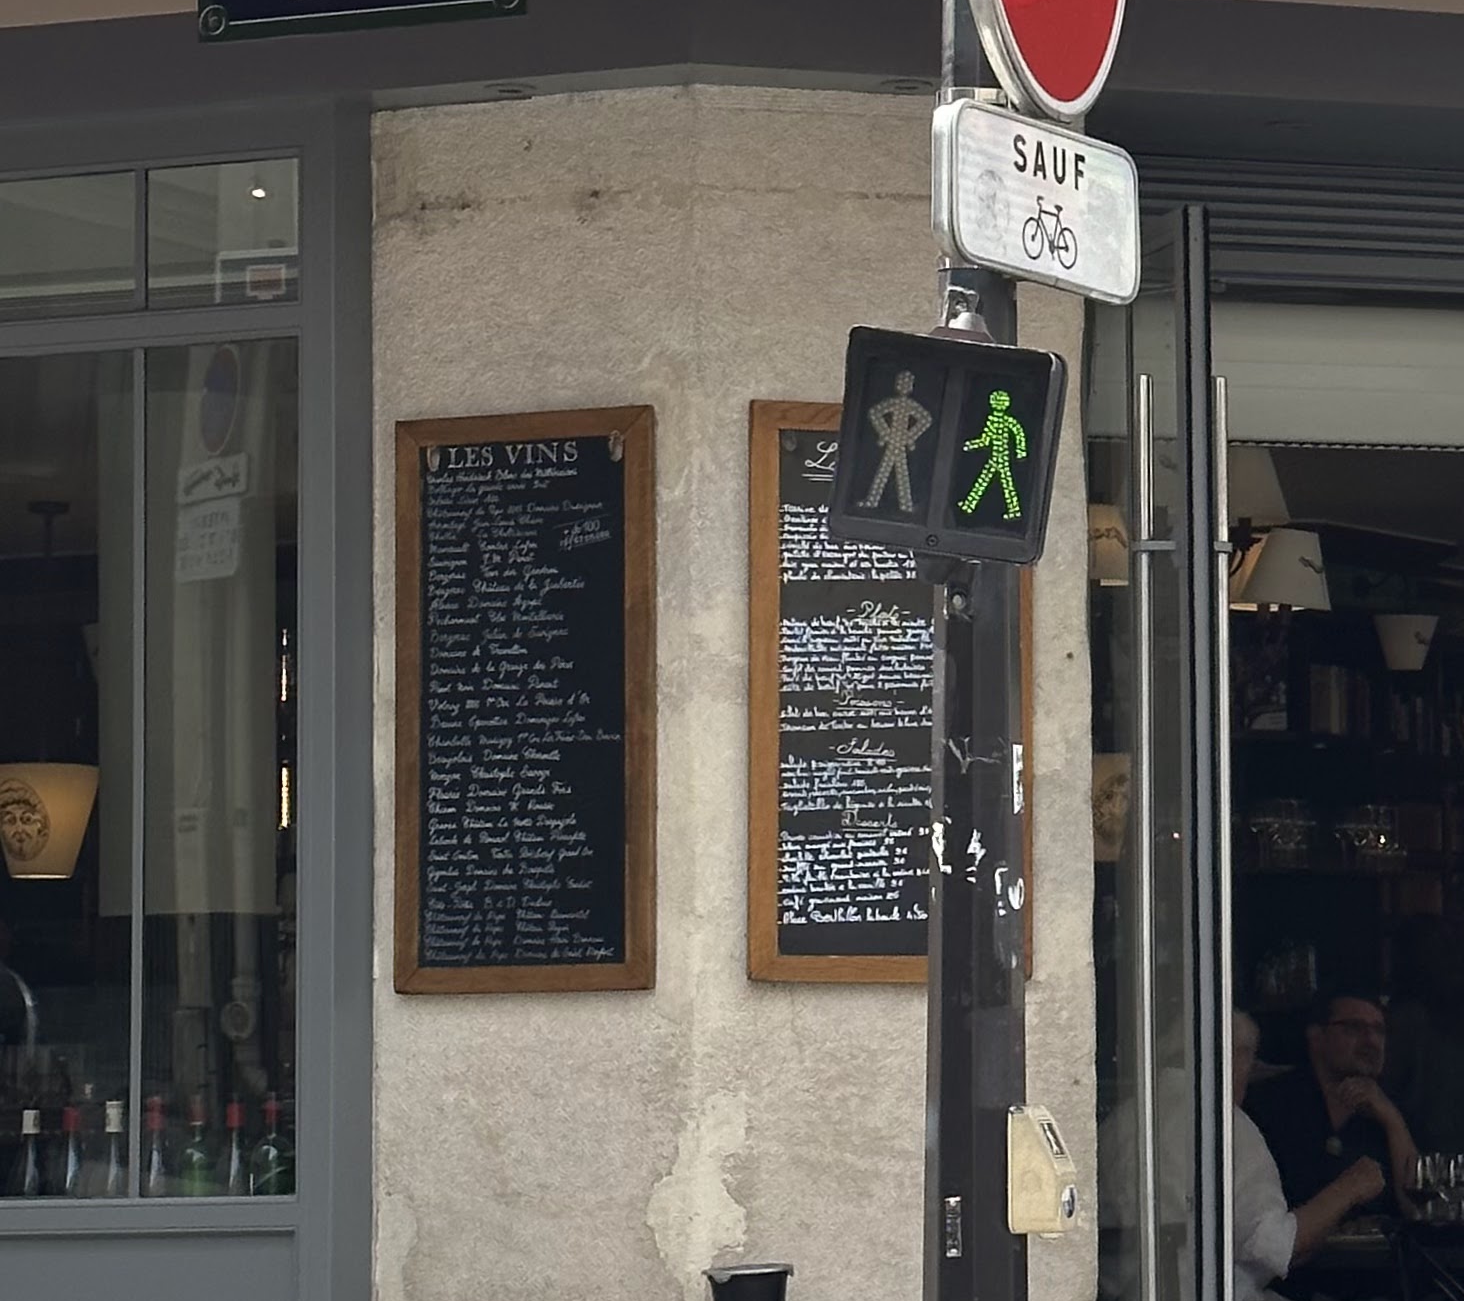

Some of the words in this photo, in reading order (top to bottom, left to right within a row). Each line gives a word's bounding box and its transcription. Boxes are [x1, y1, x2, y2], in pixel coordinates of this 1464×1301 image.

[1013, 133, 1086, 191] SAUF
[447, 446, 494, 469] LES
[504, 440, 579, 465] VINS
